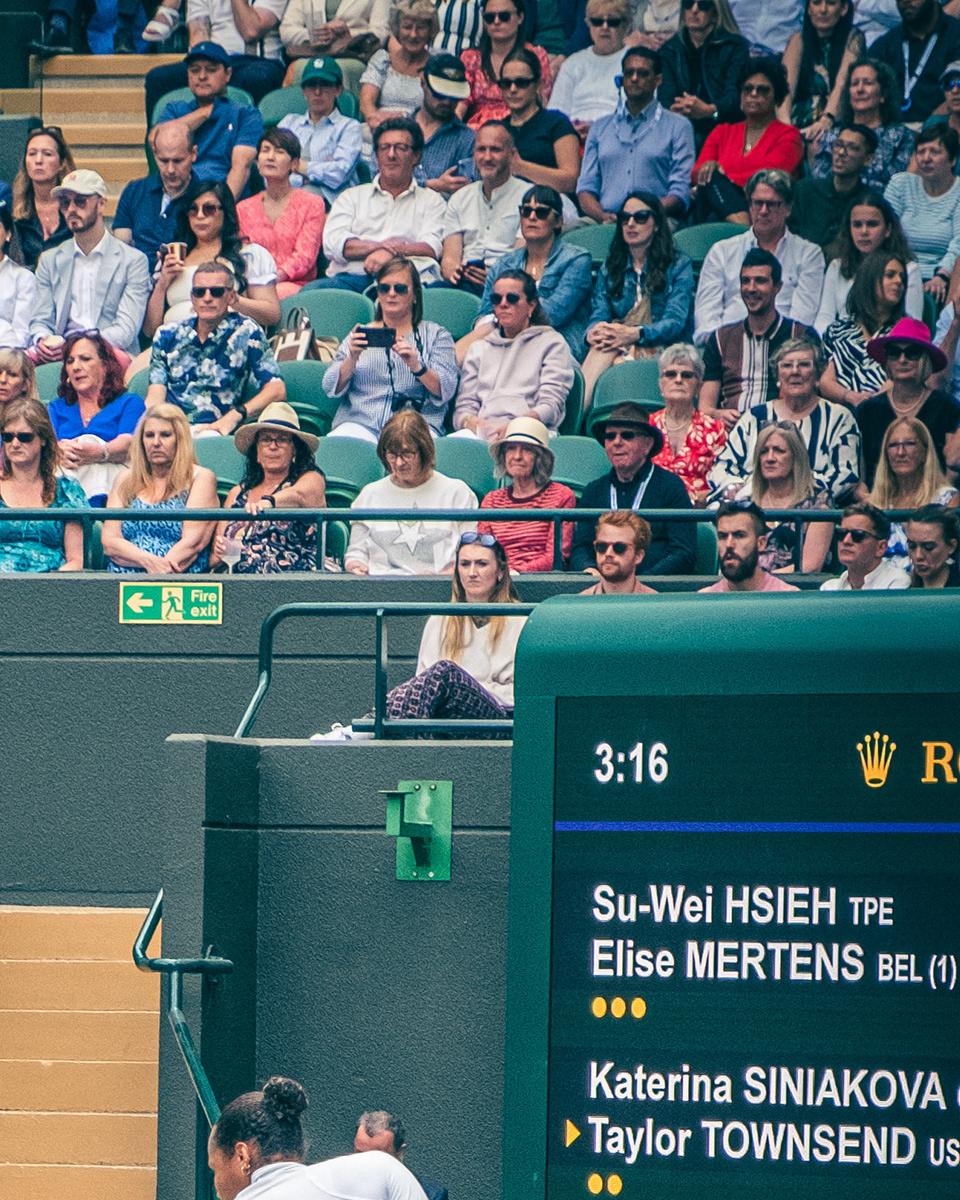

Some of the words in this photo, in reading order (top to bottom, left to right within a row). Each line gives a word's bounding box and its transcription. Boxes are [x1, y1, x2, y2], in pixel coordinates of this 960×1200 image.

[190, 589, 218, 603] Fire
[190, 603, 218, 617] exit
[594, 742, 669, 783] 3:16
[921, 741, 960, 783] R
[592, 884, 713, 923] Su-Wei
[725, 885, 836, 925] HSIEH
[849, 896, 894, 926] TPE
[592, 938, 675, 978] Elise
[686, 940, 865, 981] MERTENS
[878, 953, 923, 982] BEL
[929, 954, 957, 990] (1)
[589, 1060, 733, 1104] Katerina
[743, 1066, 947, 1110] SINIAKOVA
[587, 1115, 693, 1164] Taylor
[700, 1119, 916, 1165] TOWNSEND
